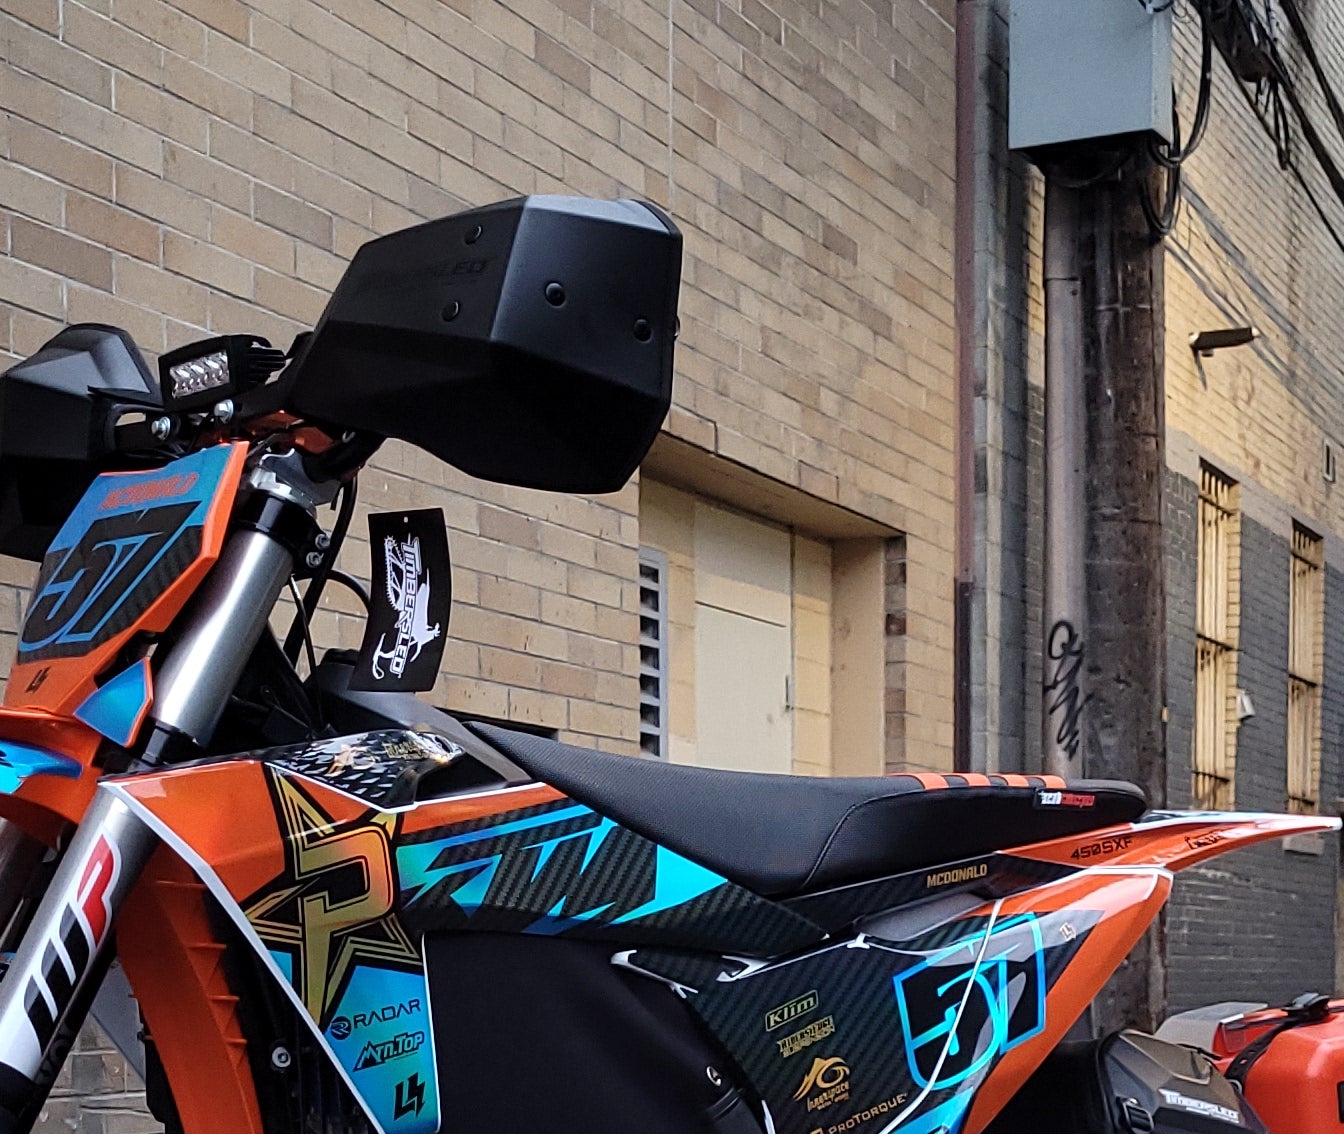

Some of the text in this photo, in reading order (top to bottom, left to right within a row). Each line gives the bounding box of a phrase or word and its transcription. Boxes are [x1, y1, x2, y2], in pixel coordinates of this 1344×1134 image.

[18, 500, 205, 653] 57
[926, 863, 988, 888] MCDONALD
[353, 998, 421, 1029] RADAR
